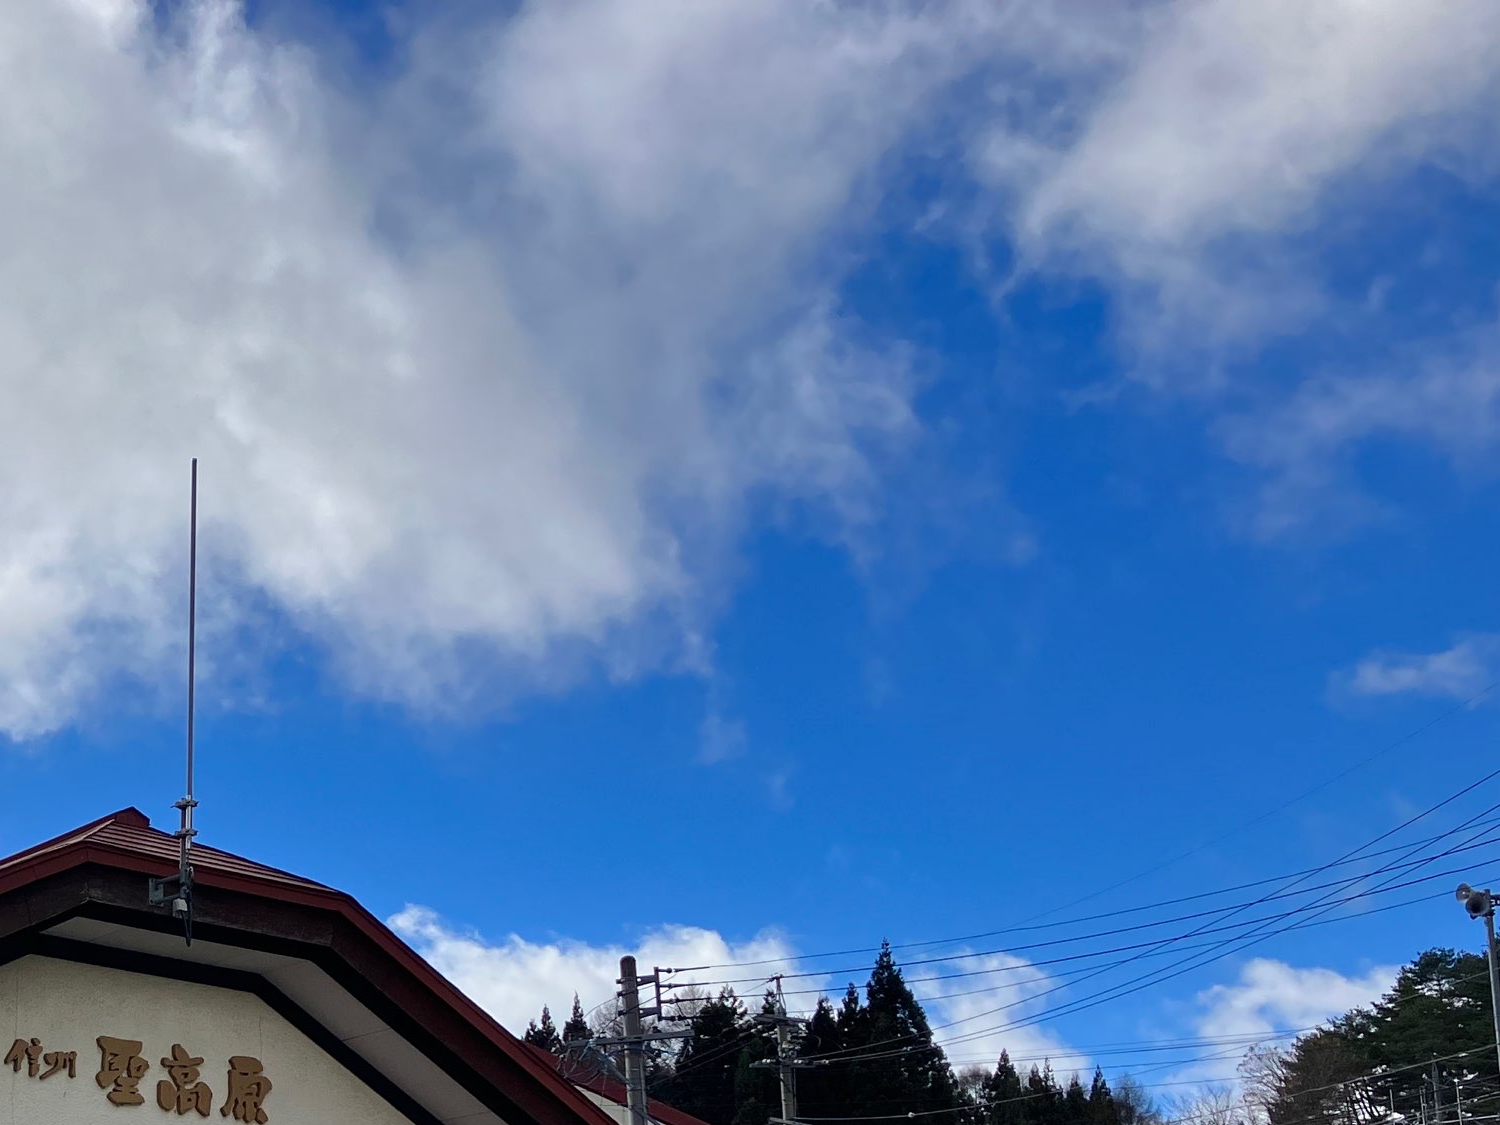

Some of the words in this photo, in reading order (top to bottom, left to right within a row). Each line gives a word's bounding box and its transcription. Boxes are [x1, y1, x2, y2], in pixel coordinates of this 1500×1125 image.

[4, 1037, 78, 1080] 信州
[95, 1035, 273, 1125] 聖高原
